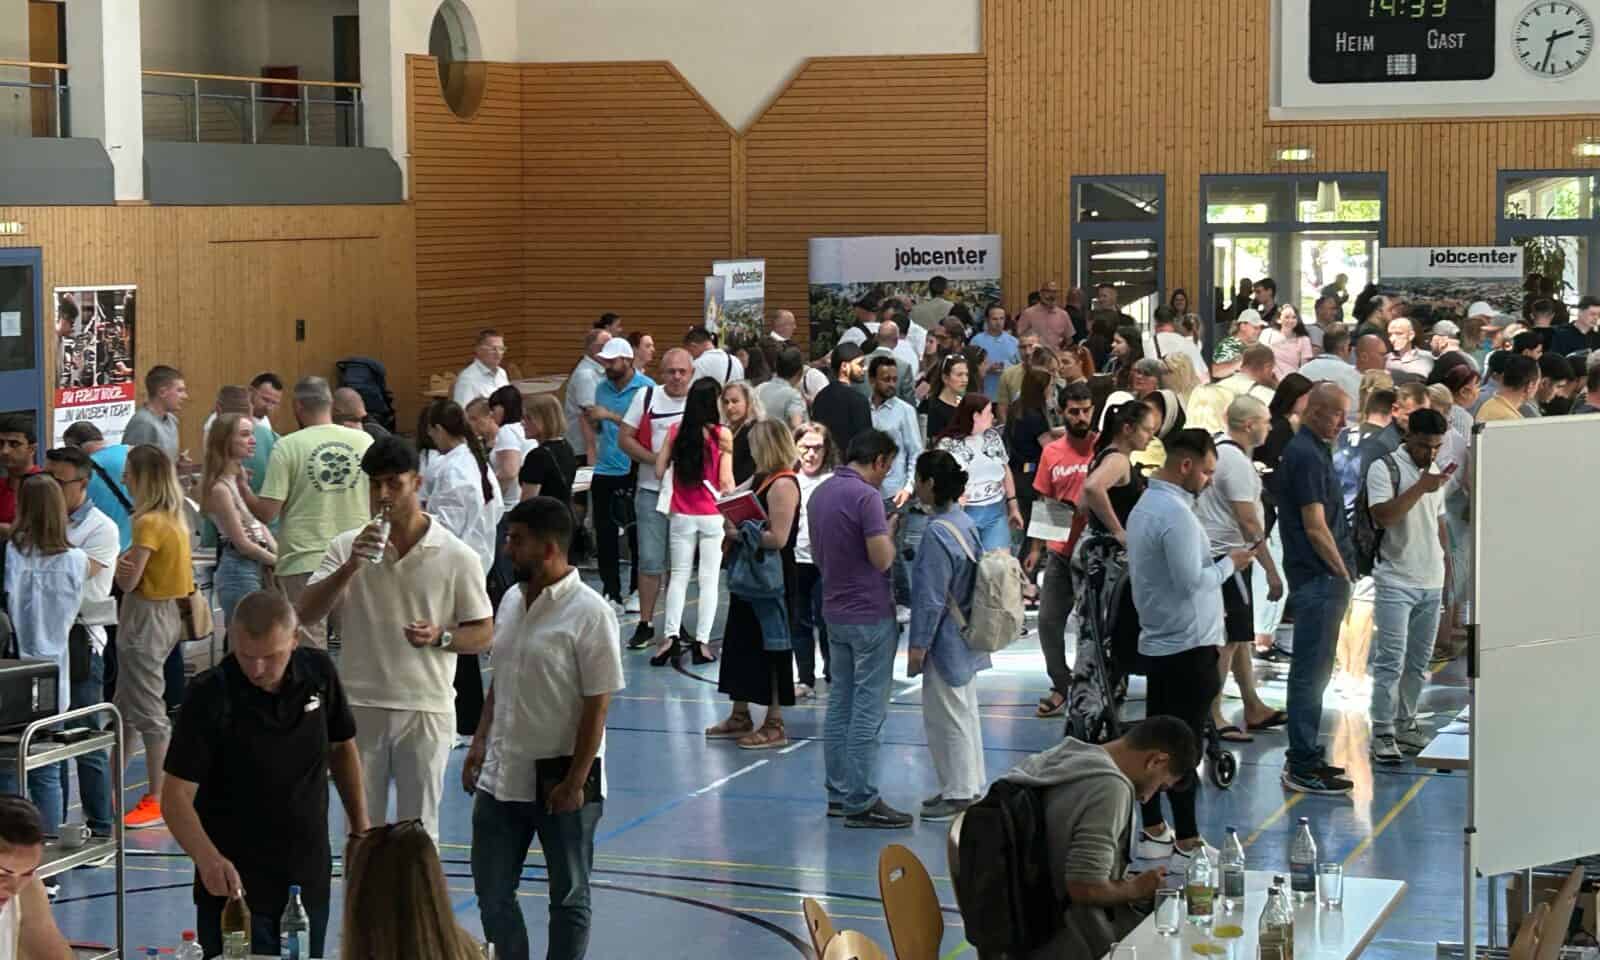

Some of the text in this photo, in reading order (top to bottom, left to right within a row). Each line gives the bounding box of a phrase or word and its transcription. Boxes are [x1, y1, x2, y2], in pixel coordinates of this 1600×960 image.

[895, 247, 987, 271] jobcenter
[1429, 249, 1517, 267] jobcenter
[731, 267, 762, 288] jobcenter
